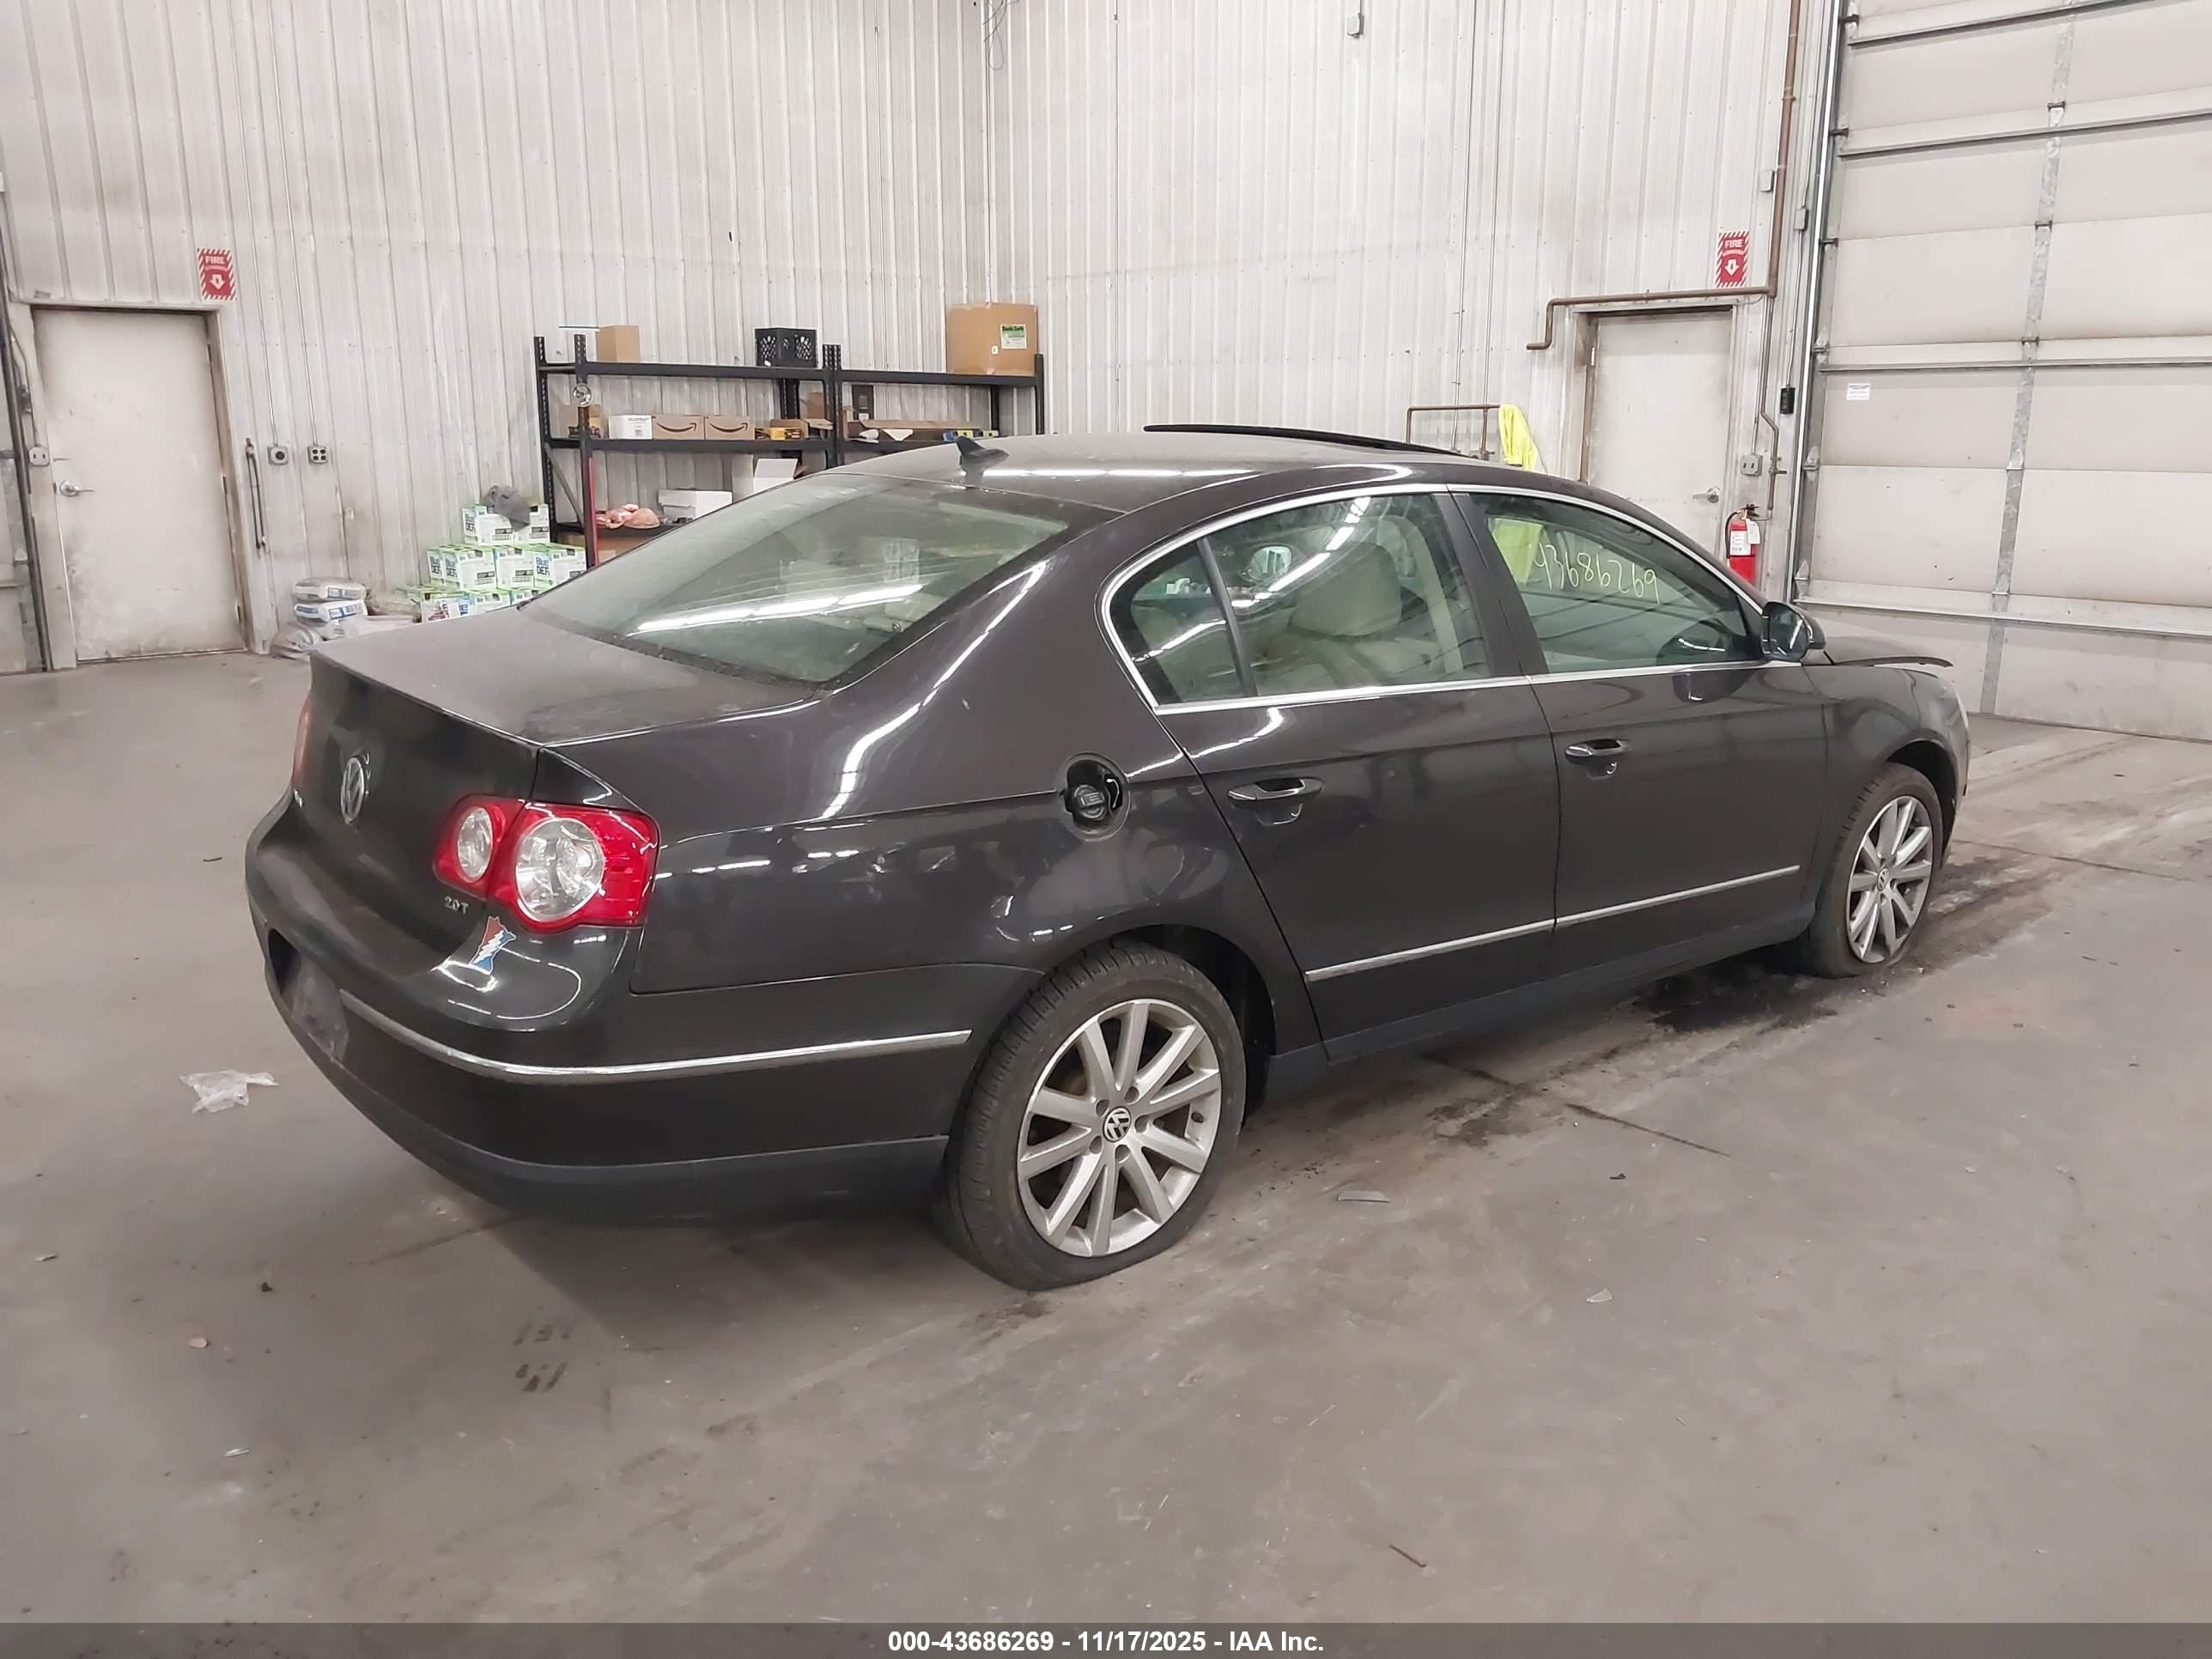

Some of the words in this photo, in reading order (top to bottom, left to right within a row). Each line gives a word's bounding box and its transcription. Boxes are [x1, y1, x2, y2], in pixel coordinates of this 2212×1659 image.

[1724, 239, 1744, 248] FIRE
[205, 256, 225, 264] FIRE
[1529, 543, 1661, 605] 43686269
